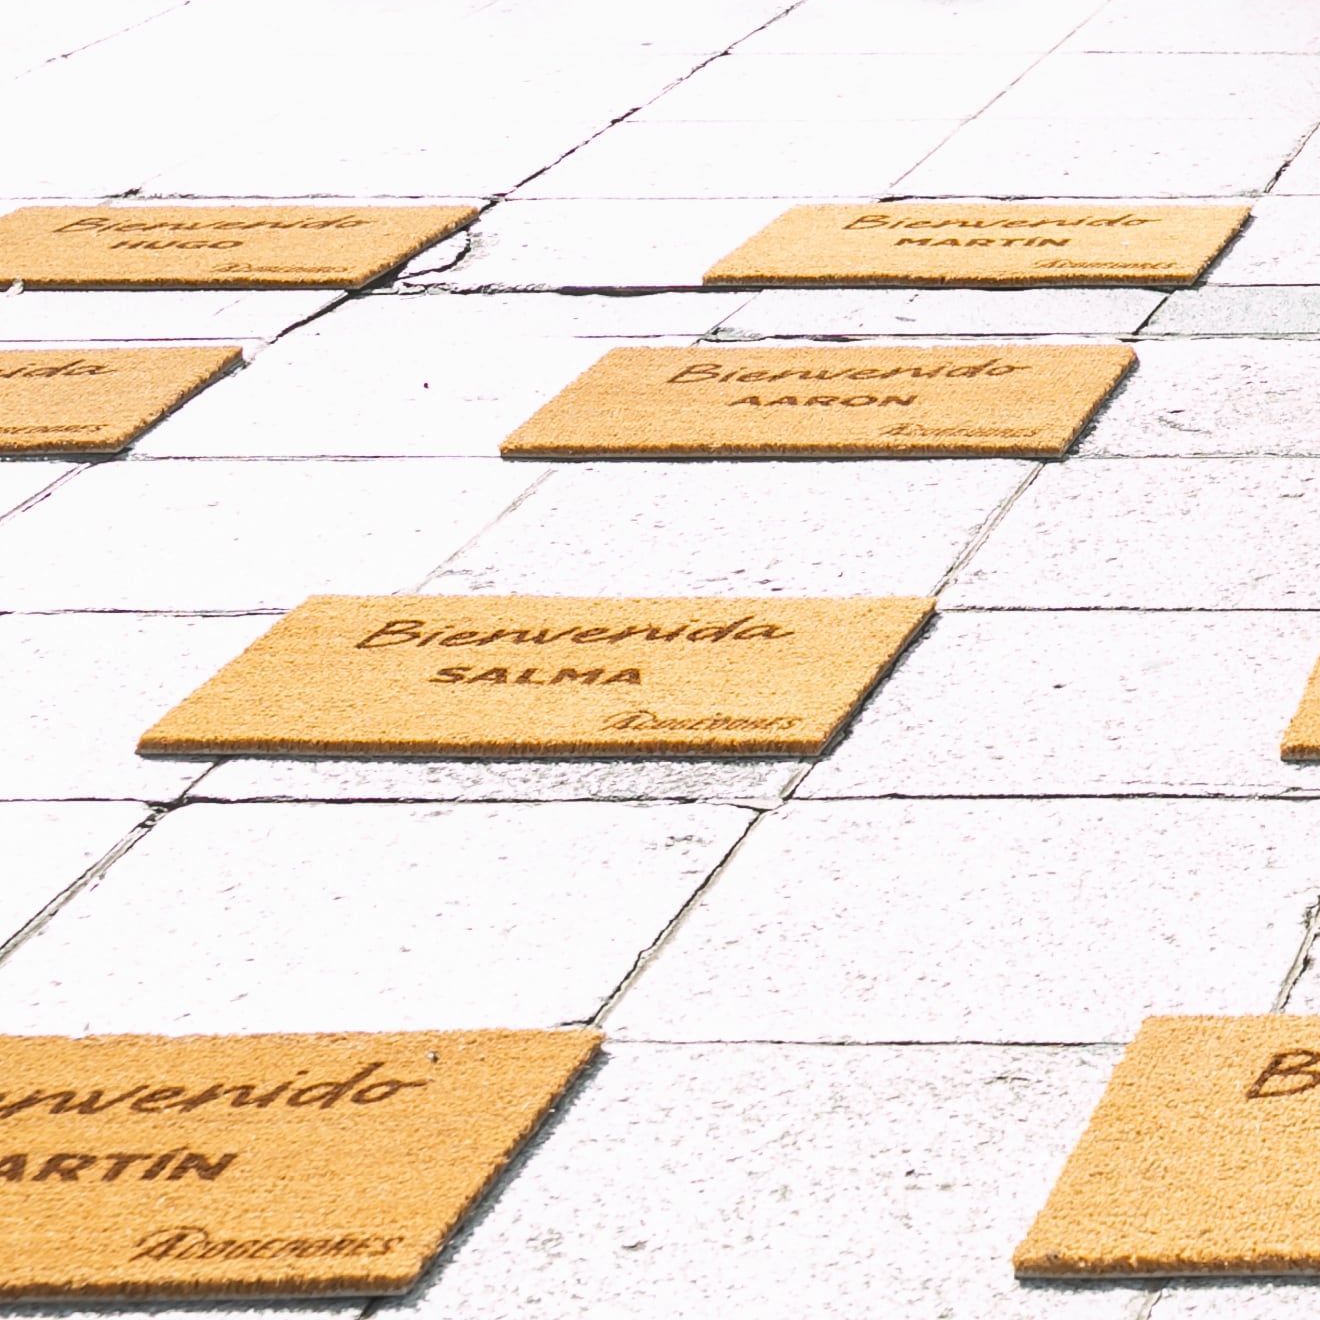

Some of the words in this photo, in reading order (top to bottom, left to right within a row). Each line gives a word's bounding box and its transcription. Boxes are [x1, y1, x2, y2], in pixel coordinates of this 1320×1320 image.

[53, 213, 379, 233] Bienvenido
[841, 212, 1161, 231] Bienvenido
[110, 238, 244, 250] HUGO
[894, 235, 1073, 248] MARTÍN
[668, 358, 1031, 384] Bienvenido
[729, 394, 919, 407] AARON
[355, 616, 796, 651] Bienvenida
[428, 666, 643, 686] SALMA
